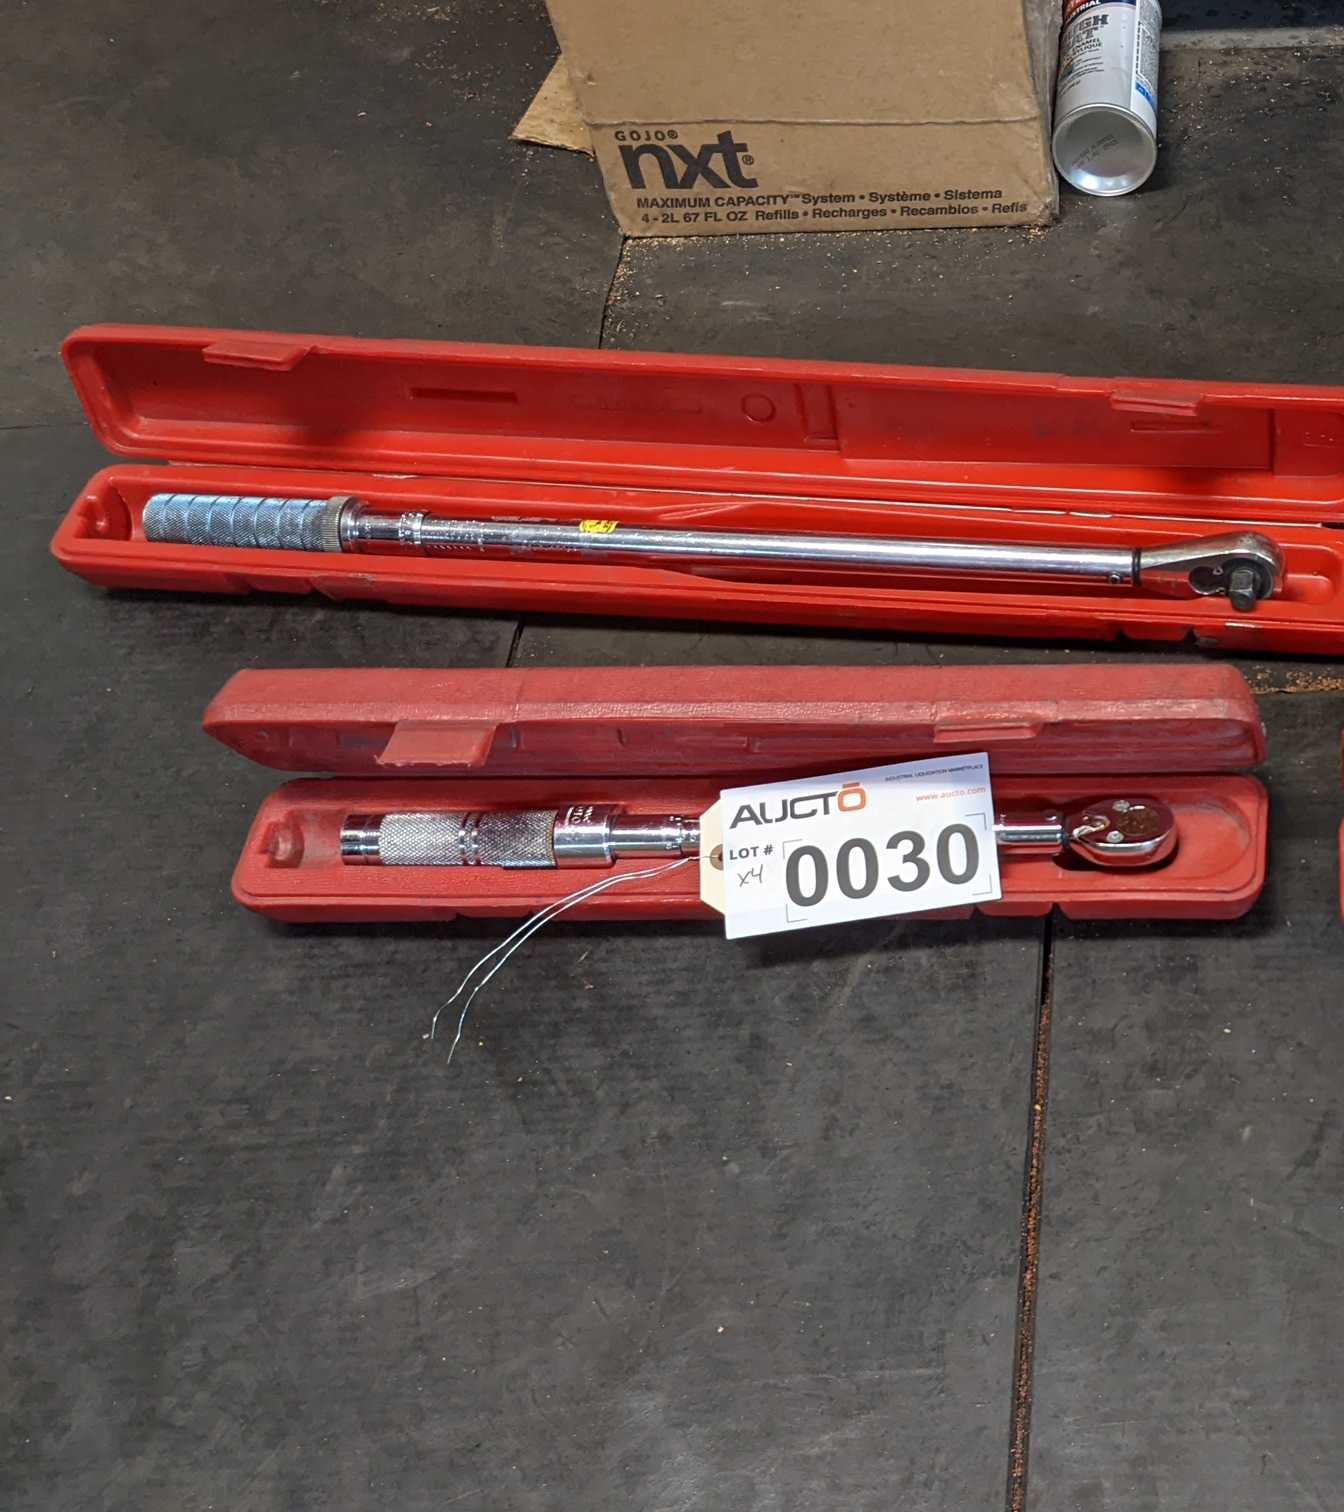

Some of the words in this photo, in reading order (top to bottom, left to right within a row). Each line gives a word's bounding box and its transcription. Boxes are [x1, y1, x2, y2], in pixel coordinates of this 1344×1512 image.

[637, 197, 711, 209] MAXIMUM
[801, 192, 856, 206] System
[868, 190, 931, 205] Système
[943, 189, 1003, 201] Sistema
[683, 212, 700, 223] 67
[704, 212, 722, 223] FL
[726, 211, 749, 222] OZ
[755, 209, 800, 221] Refills
[812, 206, 888, 219] Recharges
[899, 204, 979, 217] Recambios
[991, 202, 1028, 214] Refis
[915, 786, 987, 802] www.aucto.com
[729, 845, 759, 861] LOT
[763, 844, 774, 856] #
[785, 823, 980, 908] 0030
